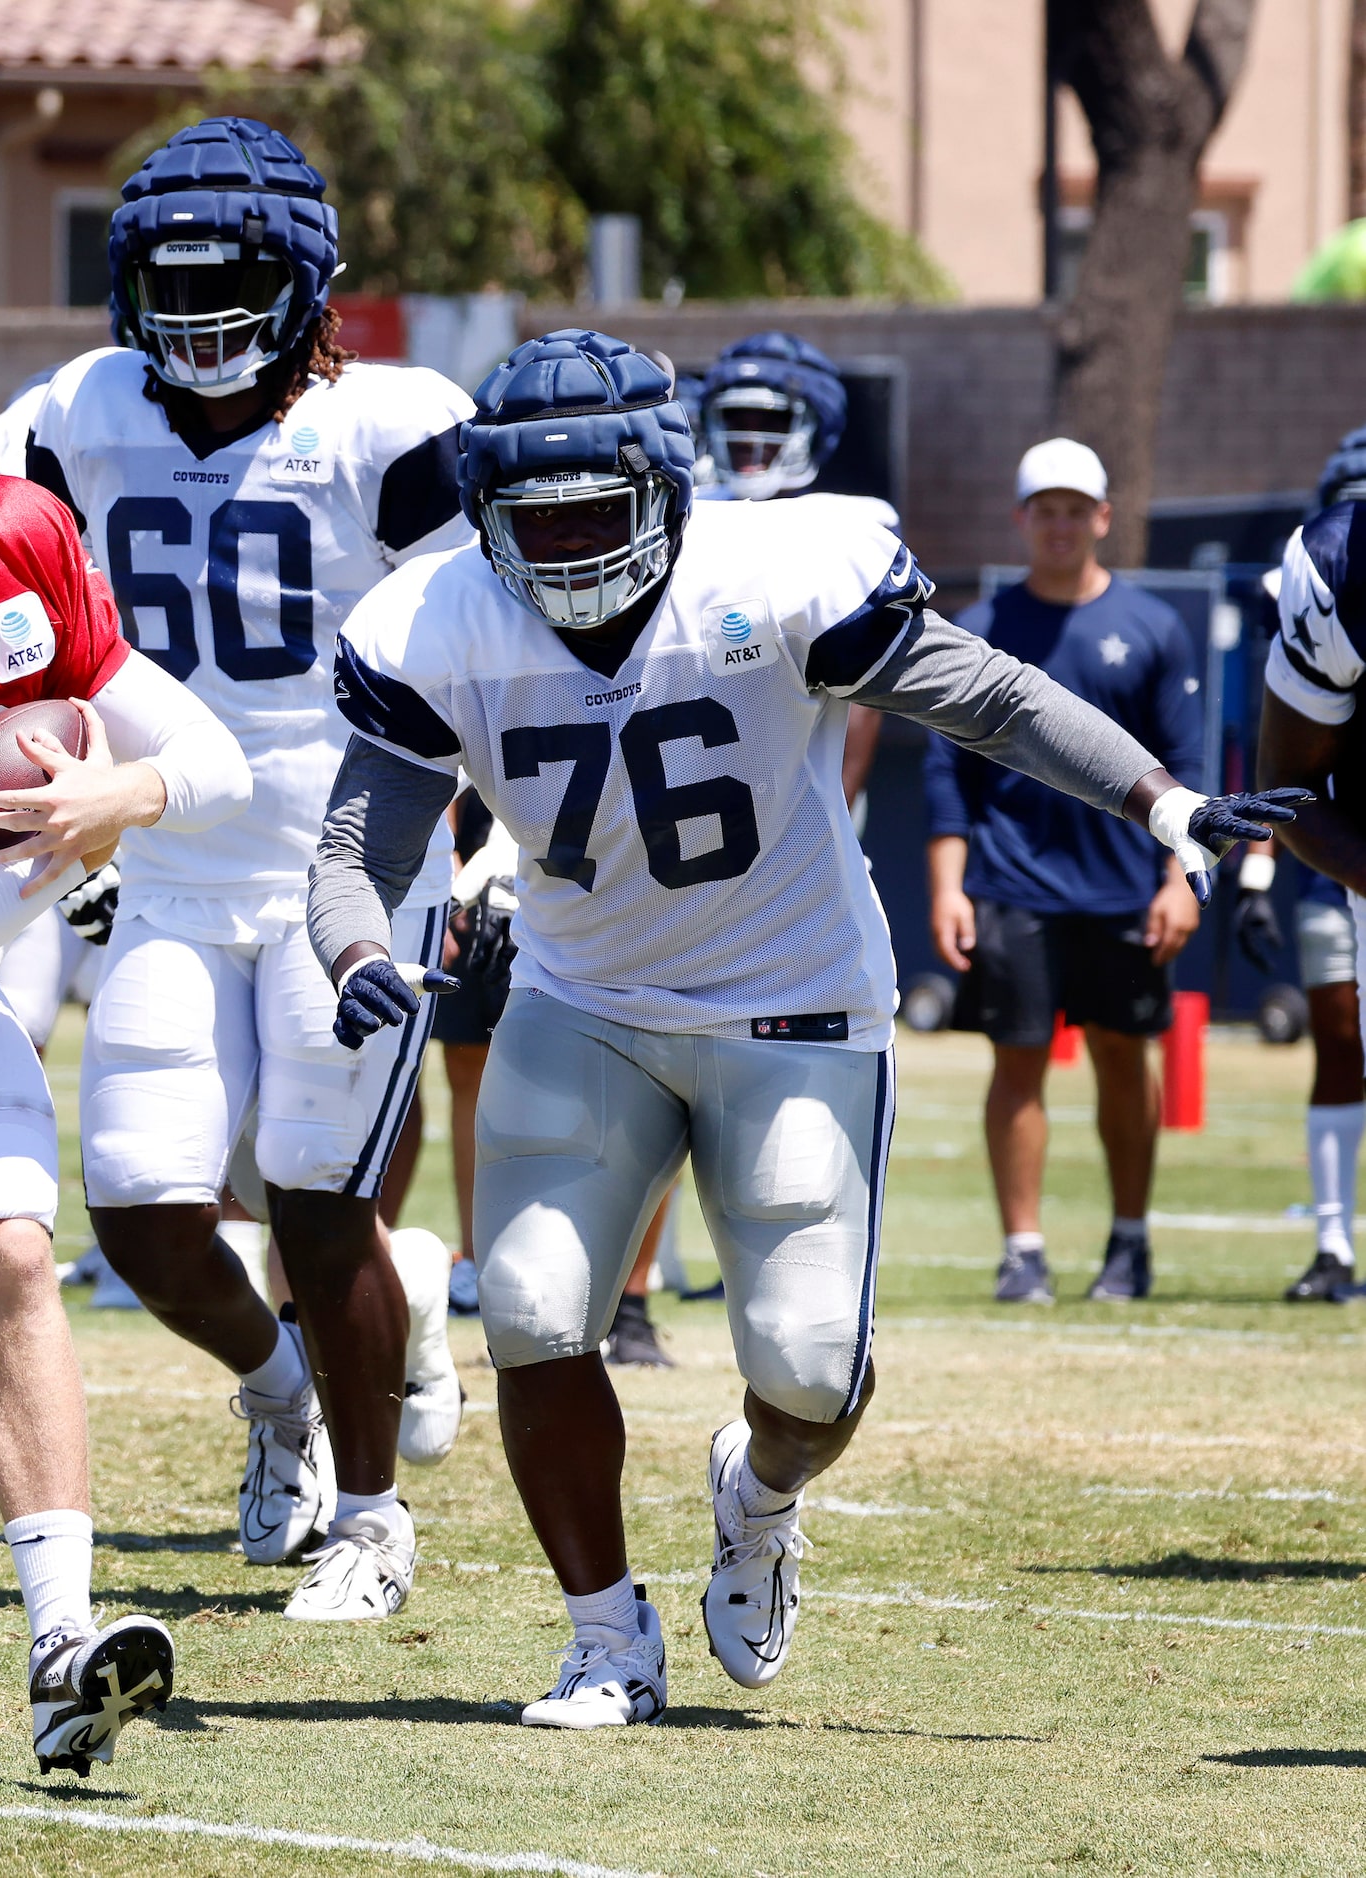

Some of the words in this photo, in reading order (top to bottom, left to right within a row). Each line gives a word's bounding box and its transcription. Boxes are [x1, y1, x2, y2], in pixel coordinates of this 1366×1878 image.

[166, 243, 211, 252] COWBOYS
[172, 470, 230, 484] COWBOYS
[284, 458, 320, 474] AT&T
[106, 496, 320, 682] 60
[7, 642, 44, 670] AT&T
[724, 644, 762, 665] AT&T
[585, 682, 642, 707] COWBOYS
[500, 696, 761, 893] 76
